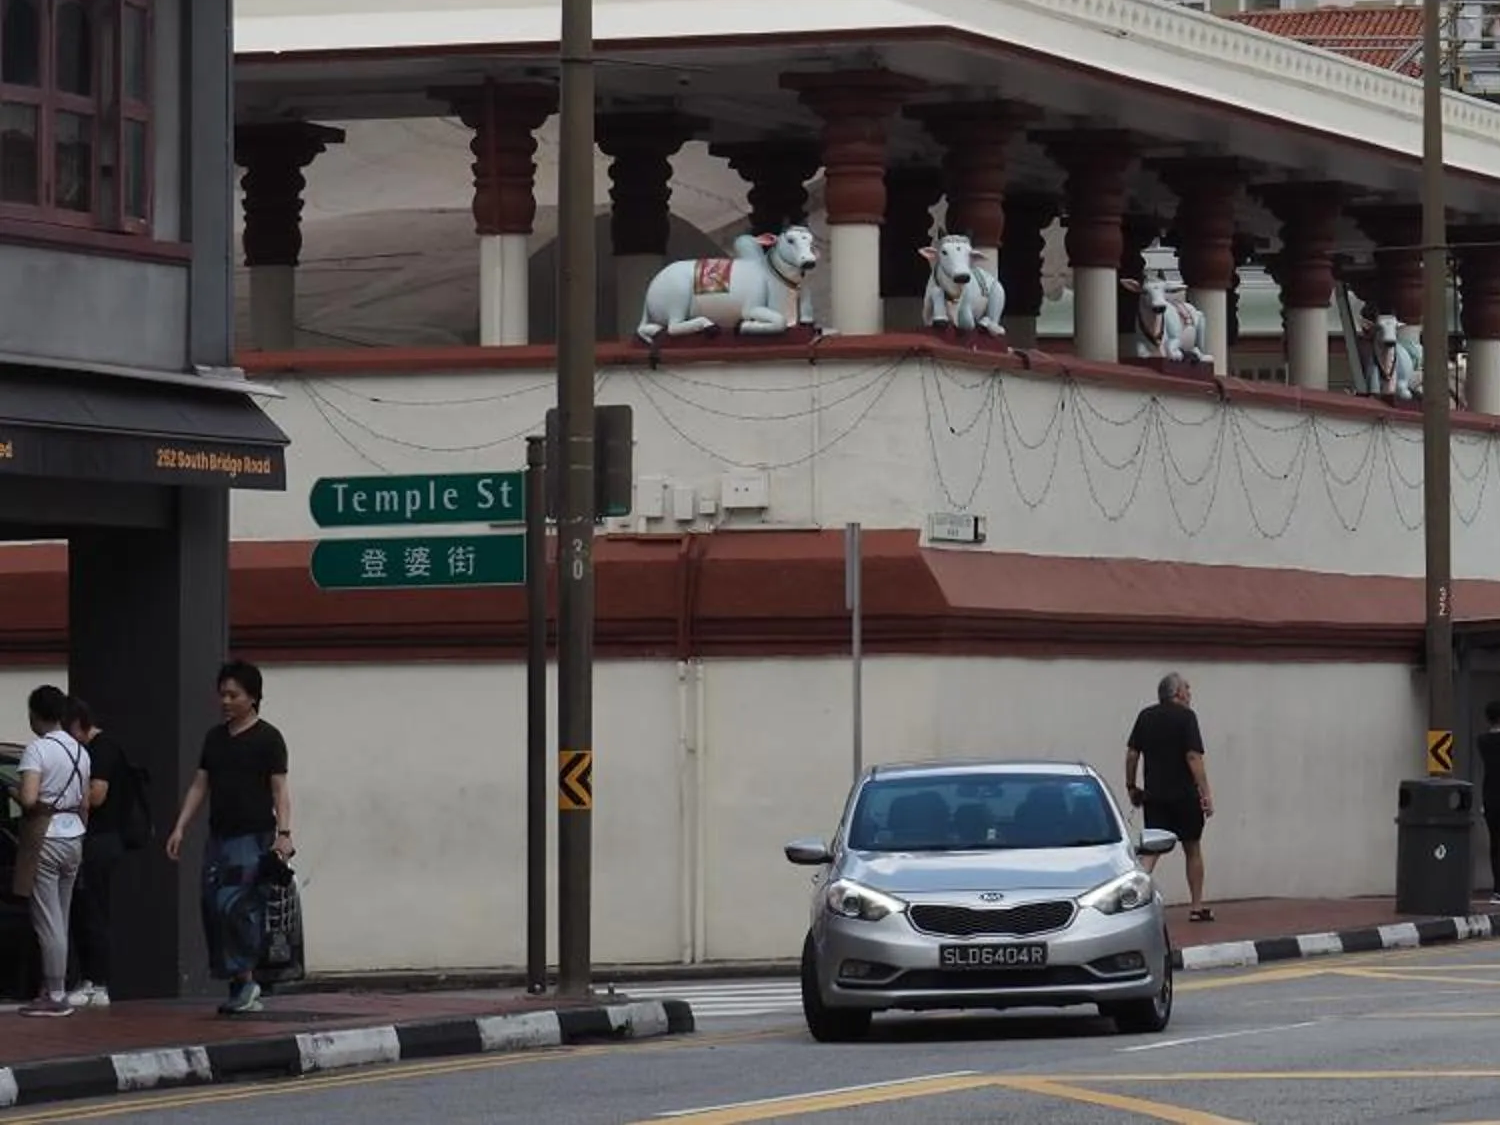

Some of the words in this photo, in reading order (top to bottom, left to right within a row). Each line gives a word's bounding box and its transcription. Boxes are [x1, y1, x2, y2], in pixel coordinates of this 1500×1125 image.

[177, 449, 209, 470] South
[209, 451, 242, 478] Bridge
[243, 455, 271, 474] Road
[332, 480, 459, 518] Temple
[477, 478, 513, 509] St
[361, 545, 475, 578] 登婆街
[943, 947, 1043, 964] SLD6404R
